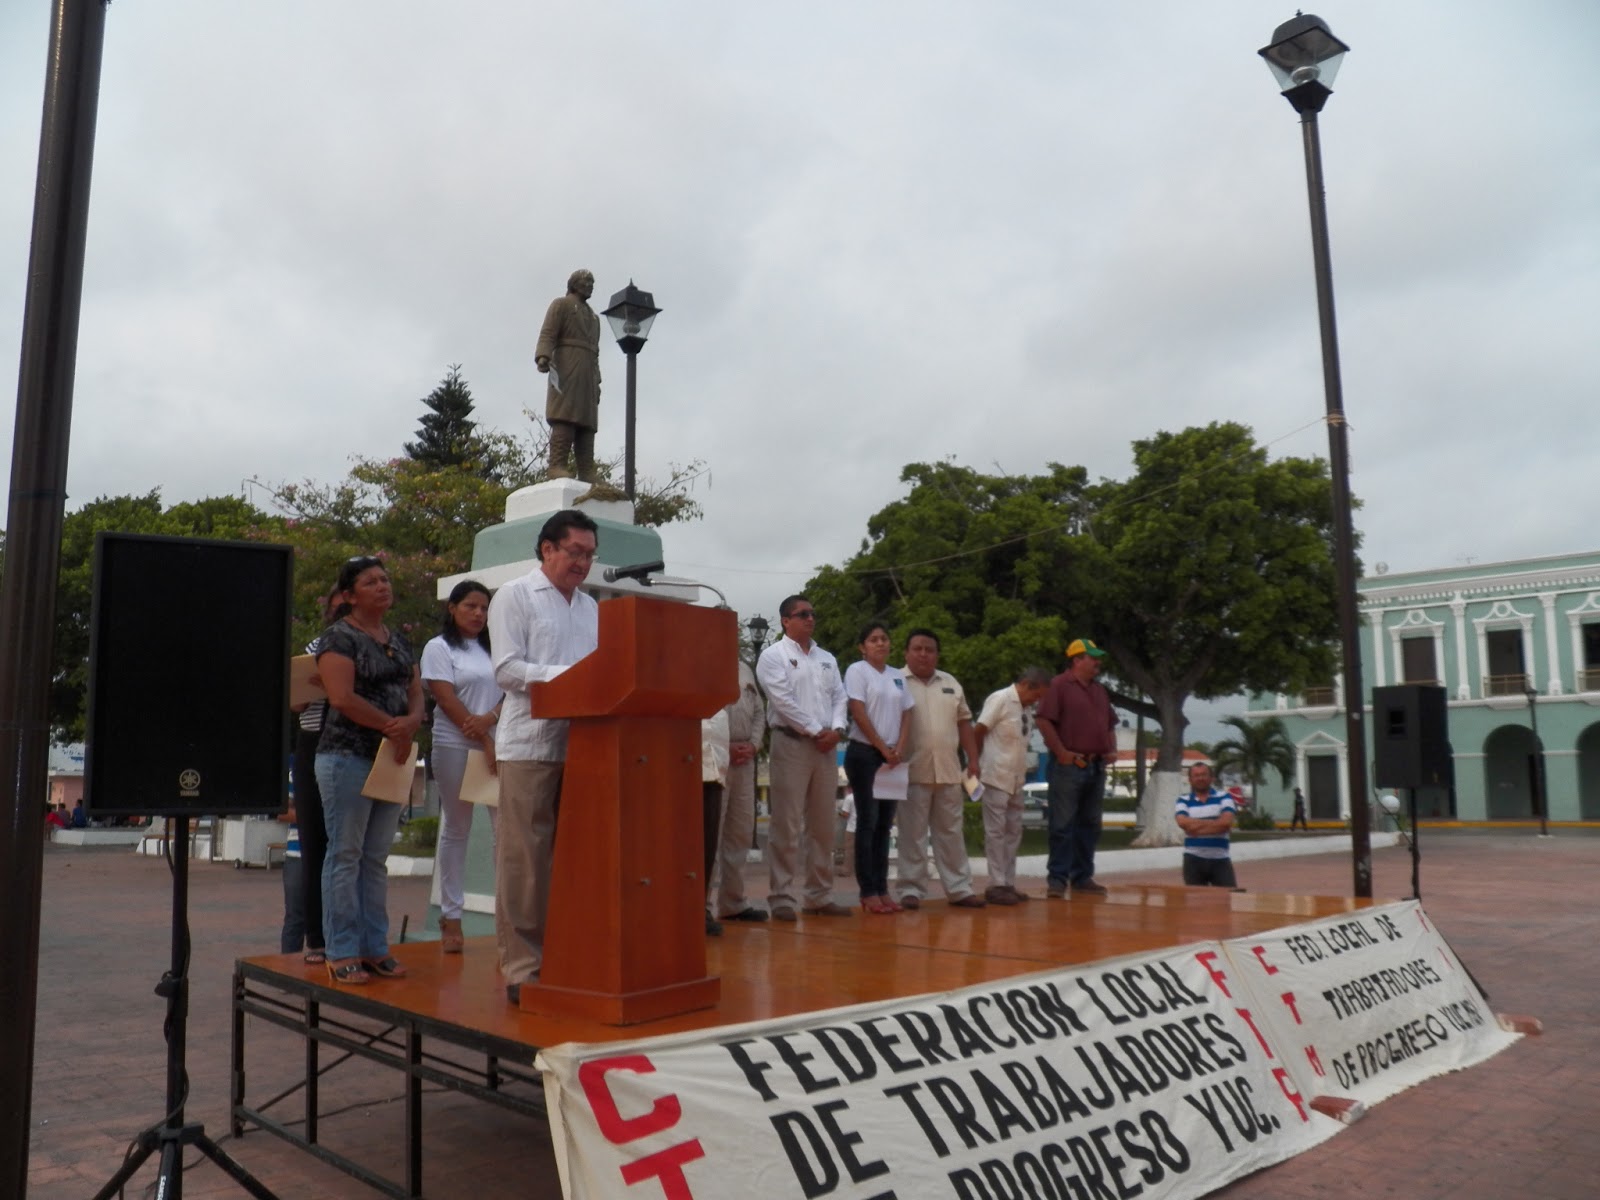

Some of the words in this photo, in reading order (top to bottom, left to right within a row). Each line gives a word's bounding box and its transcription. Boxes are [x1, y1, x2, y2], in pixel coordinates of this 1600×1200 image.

[1318, 921, 1379, 955] LOCAL
[1374, 914, 1403, 941] DE
[719, 980, 1089, 1102] FEDERACION
[1076, 961, 1208, 1026] LOCAL
[769, 1098, 890, 1200] DE
[882, 1012, 1248, 1158] TRABAJADORES
[1332, 1052, 1360, 1090] DE
[1183, 1075, 1282, 1153] YUC.
